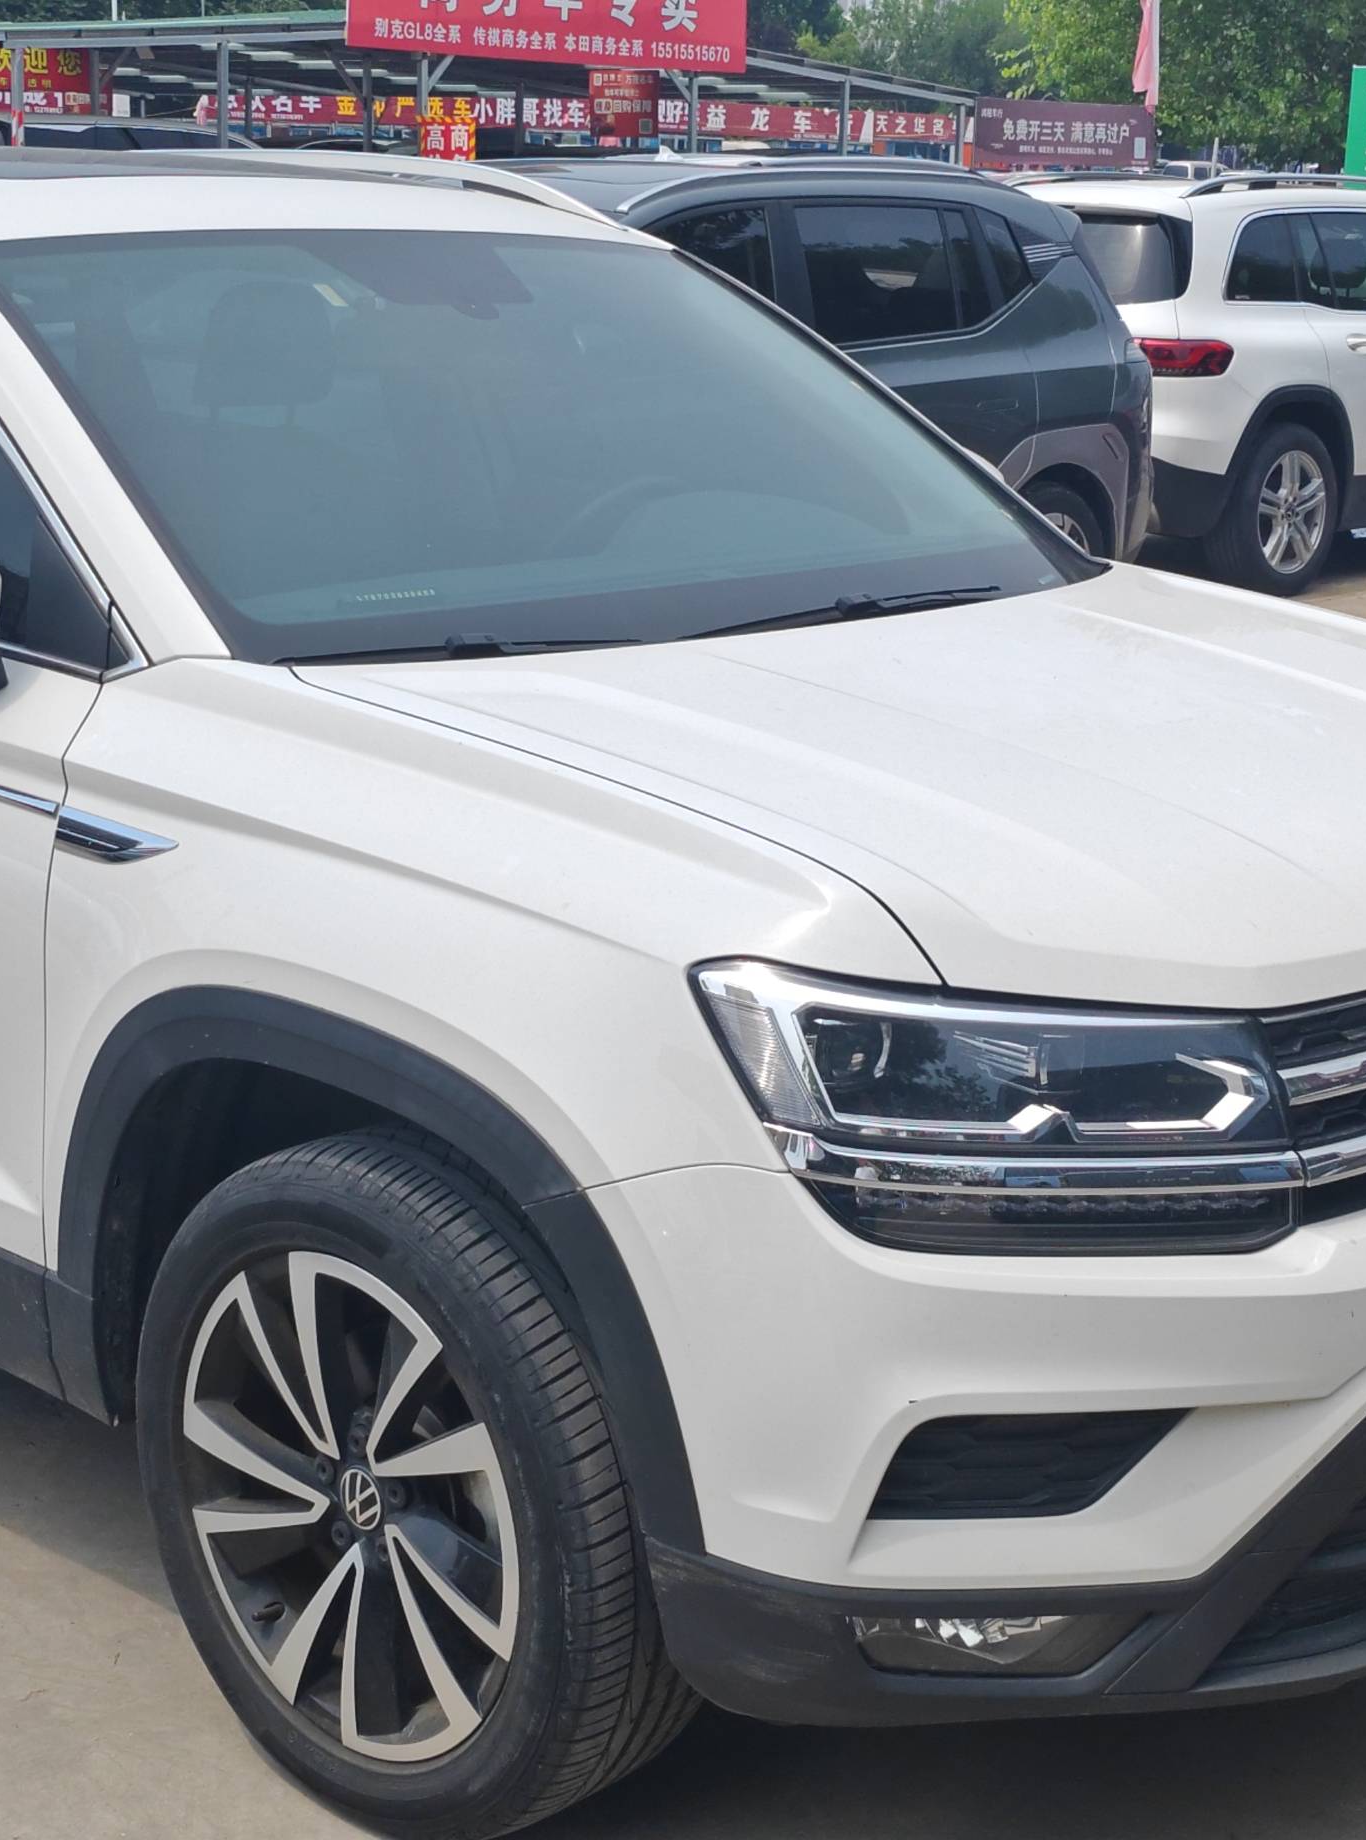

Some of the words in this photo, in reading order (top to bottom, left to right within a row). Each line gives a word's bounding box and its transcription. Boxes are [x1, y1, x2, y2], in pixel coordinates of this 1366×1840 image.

[374, 17, 462, 44] 别克GL8全系
[473, 26, 557, 51] 传祺商务全系
[564, 33, 644, 57] 本田商务全系
[651, 41, 731, 64] 15515515670
[875, 114, 957, 137] 天之华名
[1003, 118, 1065, 142] 免费开三天
[1071, 121, 1130, 144] 满意再过户
